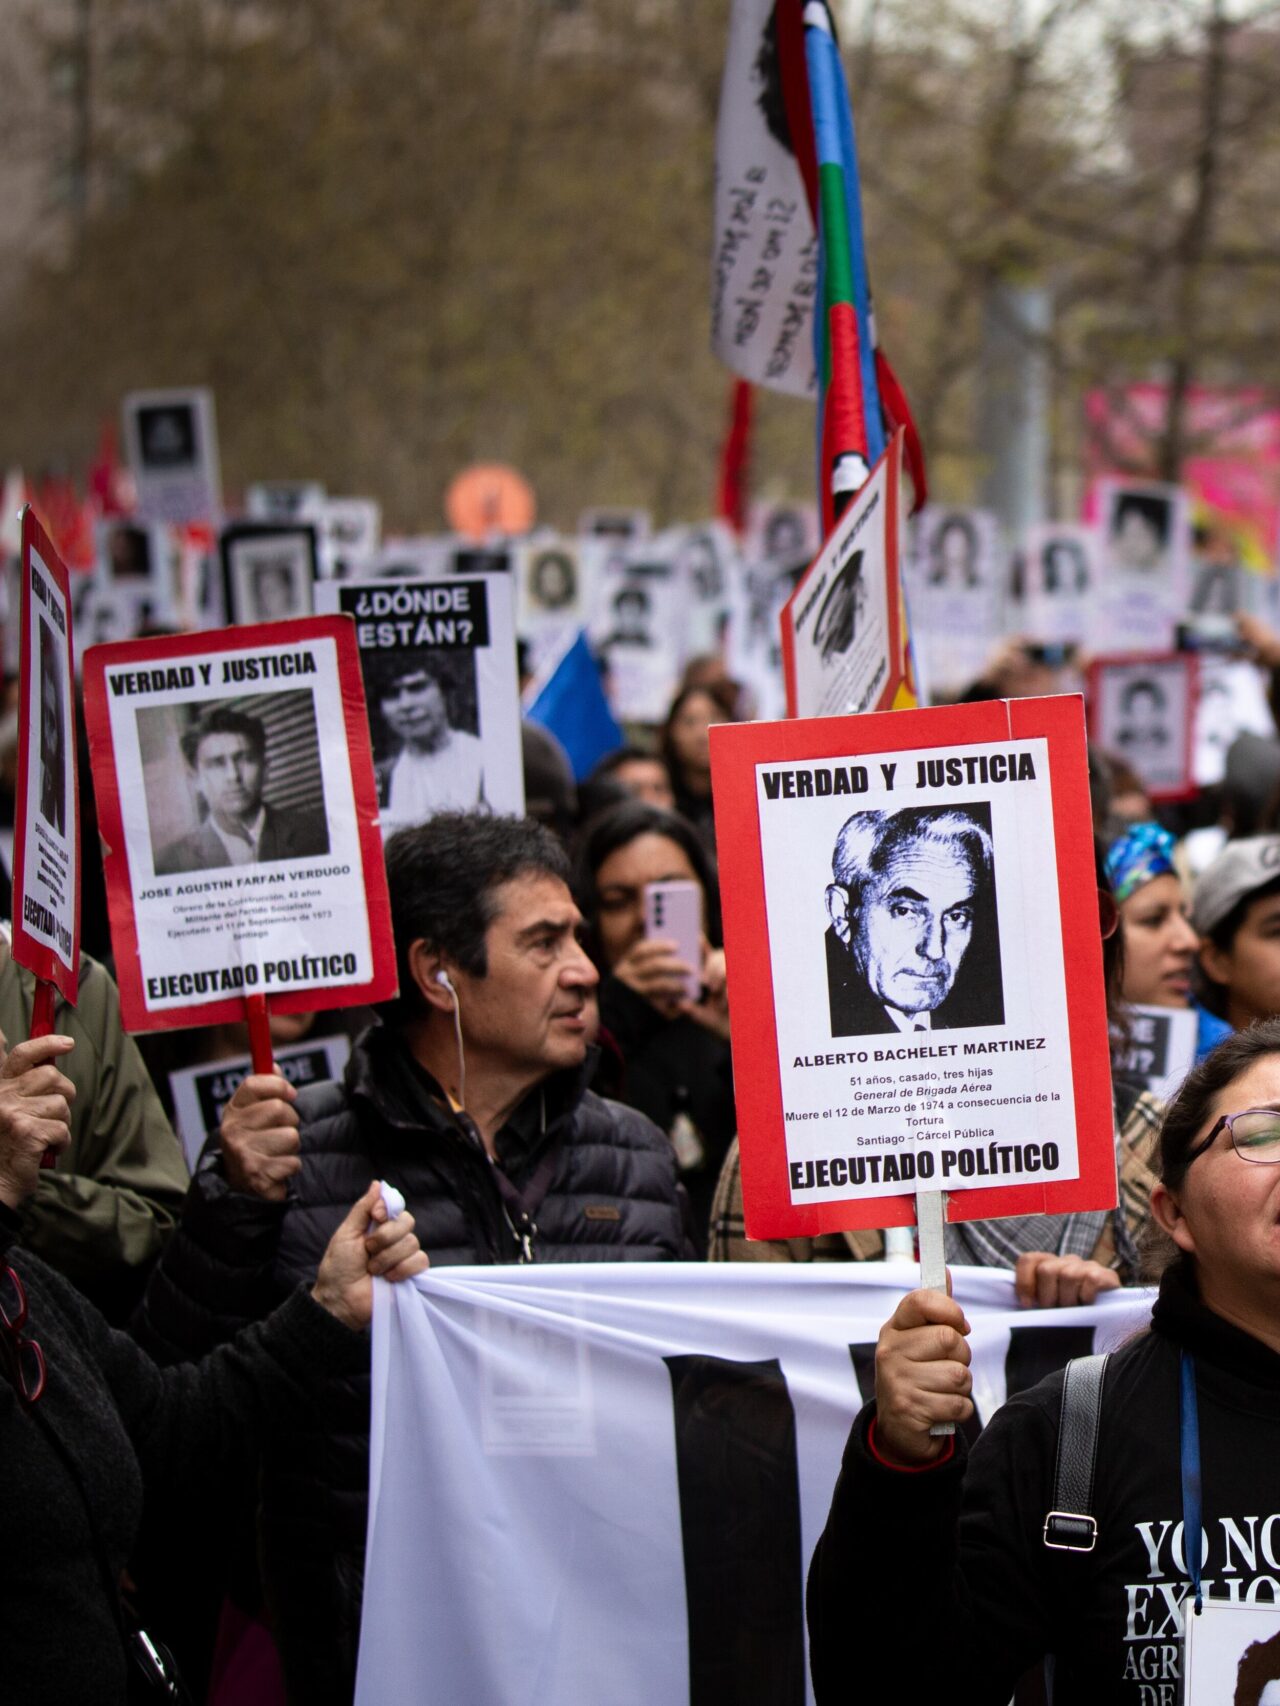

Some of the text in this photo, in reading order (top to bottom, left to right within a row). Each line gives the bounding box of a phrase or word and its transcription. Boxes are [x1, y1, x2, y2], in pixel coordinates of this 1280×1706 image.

[355, 585, 471, 617] ¿DÓNDE
[358, 616, 474, 649] ESTÁN?
[109, 651, 317, 697] VERDAD Y JUSTICIA
[761, 753, 1036, 800] VERDAD Y JUSTICIA
[139, 865, 351, 900] JOSE AGUSTIN FARFAN VERDUGO
[147, 952, 358, 1000] EJECUTADO POLÍTICO
[793, 1038, 1046, 1068] ALBERTO BACHELET MARTINEZ
[211, 1056, 315, 1099] ¿DDE
[850, 1066, 994, 1086] 51 años, casado, tres hijas
[853, 1081, 993, 1102] General de Brigada Aérea
[785, 1091, 1060, 1122] Muere el 12 de Marzo de 1974 a consecuencia de la
[905, 1115, 944, 1127] Tortura
[856, 1133, 905, 1146] Santiago
[916, 1130, 951, 1142] Cárcel
[954, 1127, 995, 1139] Pública
[790, 1141, 1060, 1190] EJECUTADO POLÍTICO
